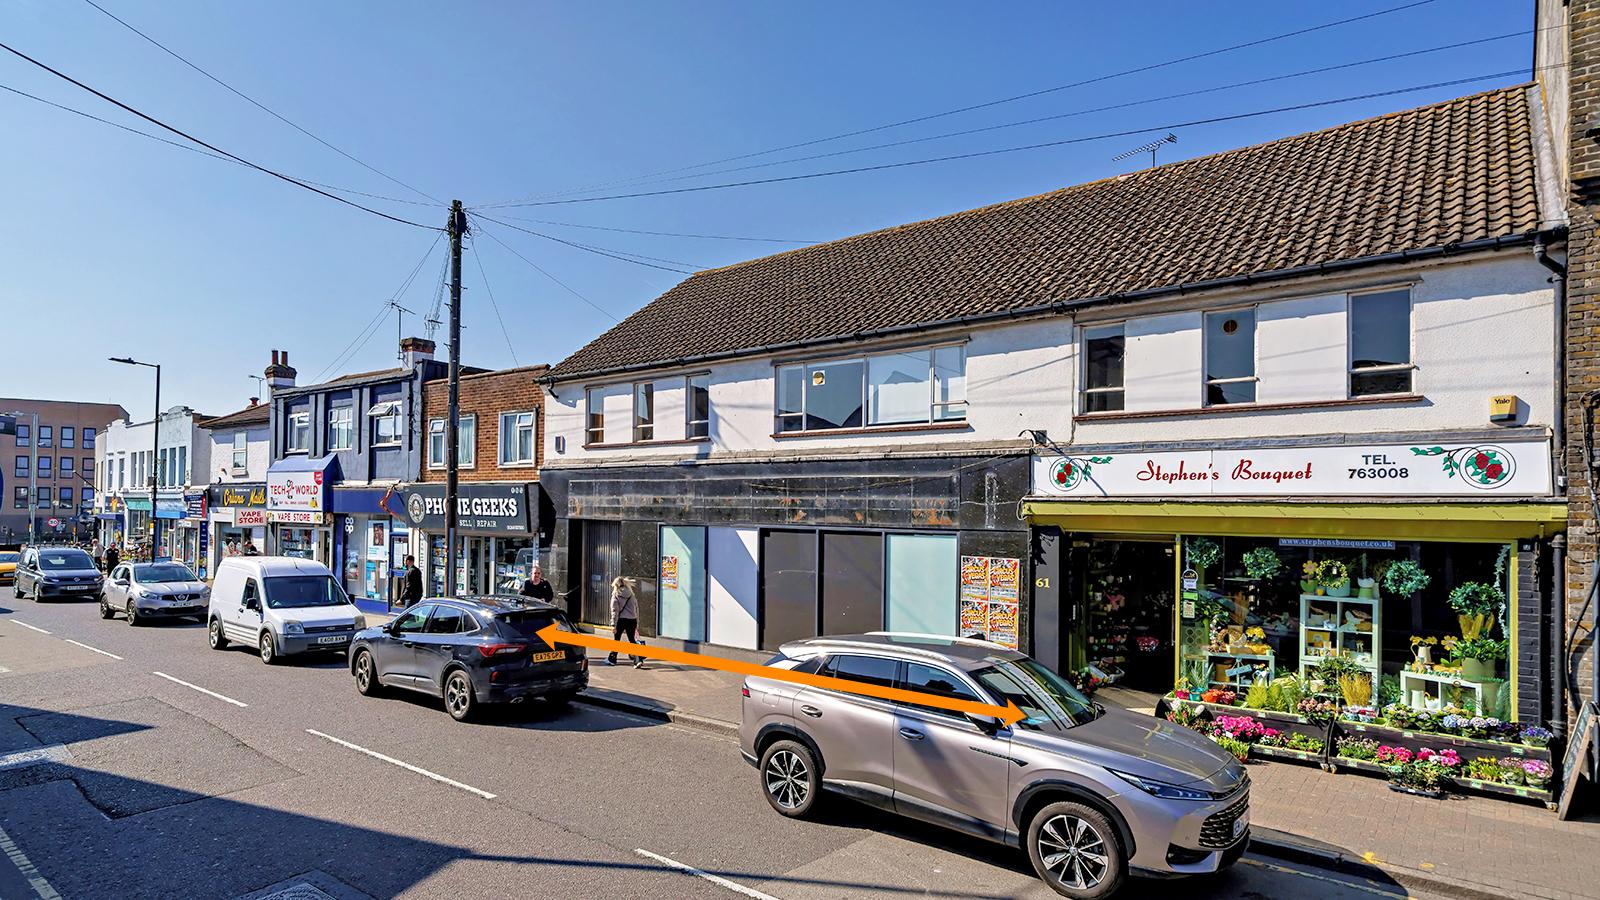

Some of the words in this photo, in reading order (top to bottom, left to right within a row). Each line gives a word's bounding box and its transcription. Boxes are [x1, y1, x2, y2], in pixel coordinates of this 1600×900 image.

[1361, 454, 1396, 465] TEL.
[1136, 459, 1220, 484] Stephen's
[1231, 458, 1313, 483] Bouquet
[1348, 467, 1409, 479] 763008
[270, 485, 286, 495] TECH
[294, 485, 319, 495] WORLD
[472, 497, 518, 517] GEEKS
[277, 512, 291, 521] VAPE
[293, 513, 311, 522] STORE
[476, 520, 497, 528] REPAIR
[1281, 538, 1393, 548] www.stephensbouquet.co.uk
[1035, 578, 1050, 589] 61
